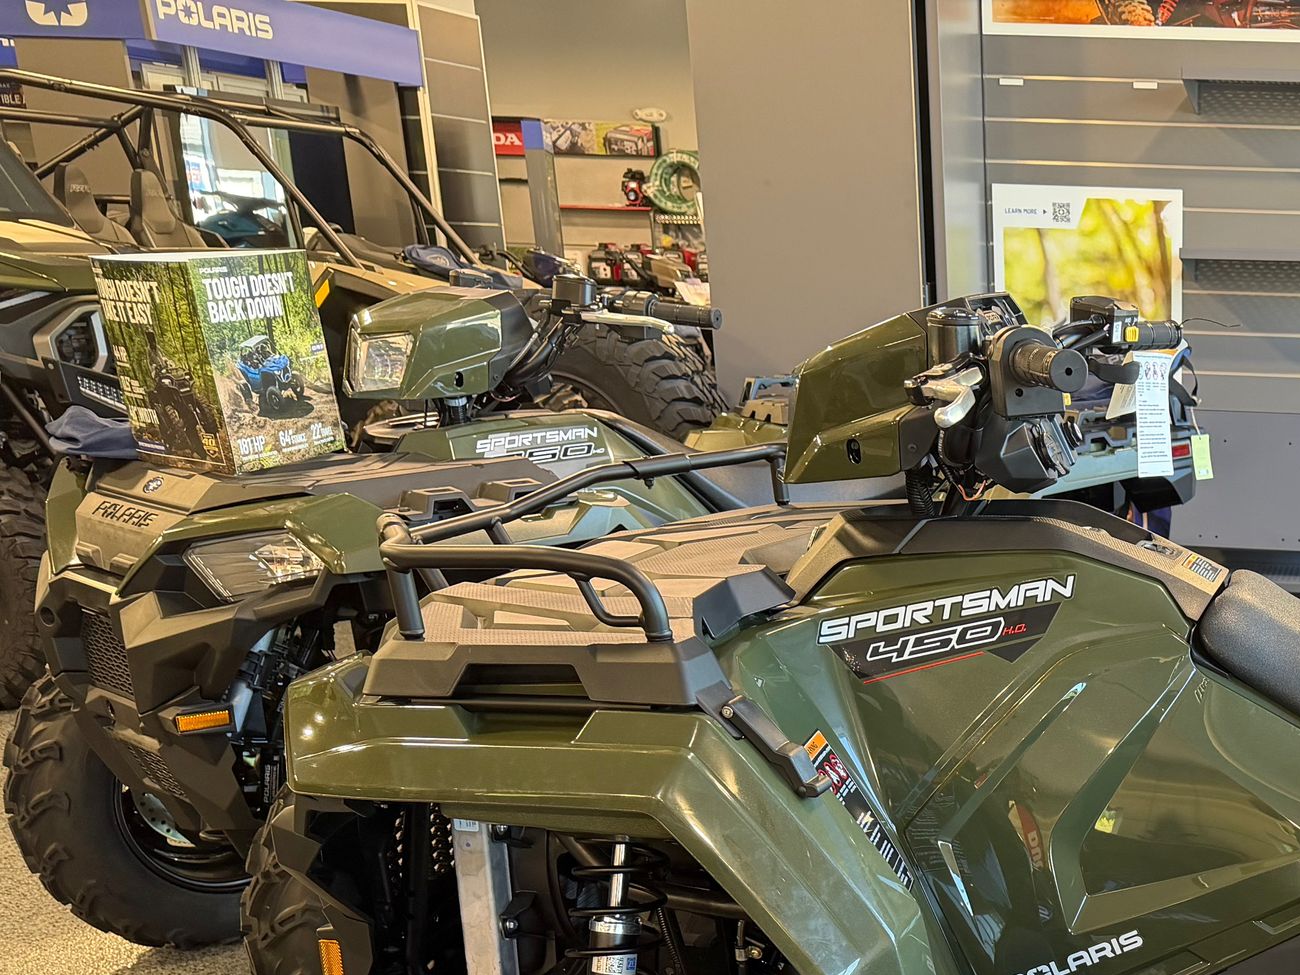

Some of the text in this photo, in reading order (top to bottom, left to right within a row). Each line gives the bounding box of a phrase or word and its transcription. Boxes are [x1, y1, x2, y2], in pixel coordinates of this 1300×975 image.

[157, 0, 274, 40] POLARIS
[202, 271, 295, 300] TOUGH DOESN'T
[207, 295, 284, 323] BACK DOWN
[253, 435, 266, 452] HP
[476, 427, 598, 454] SPORTSMAN
[817, 574, 1075, 644] SPORTSMAN
[866, 617, 1026, 663] 450 H.O.
